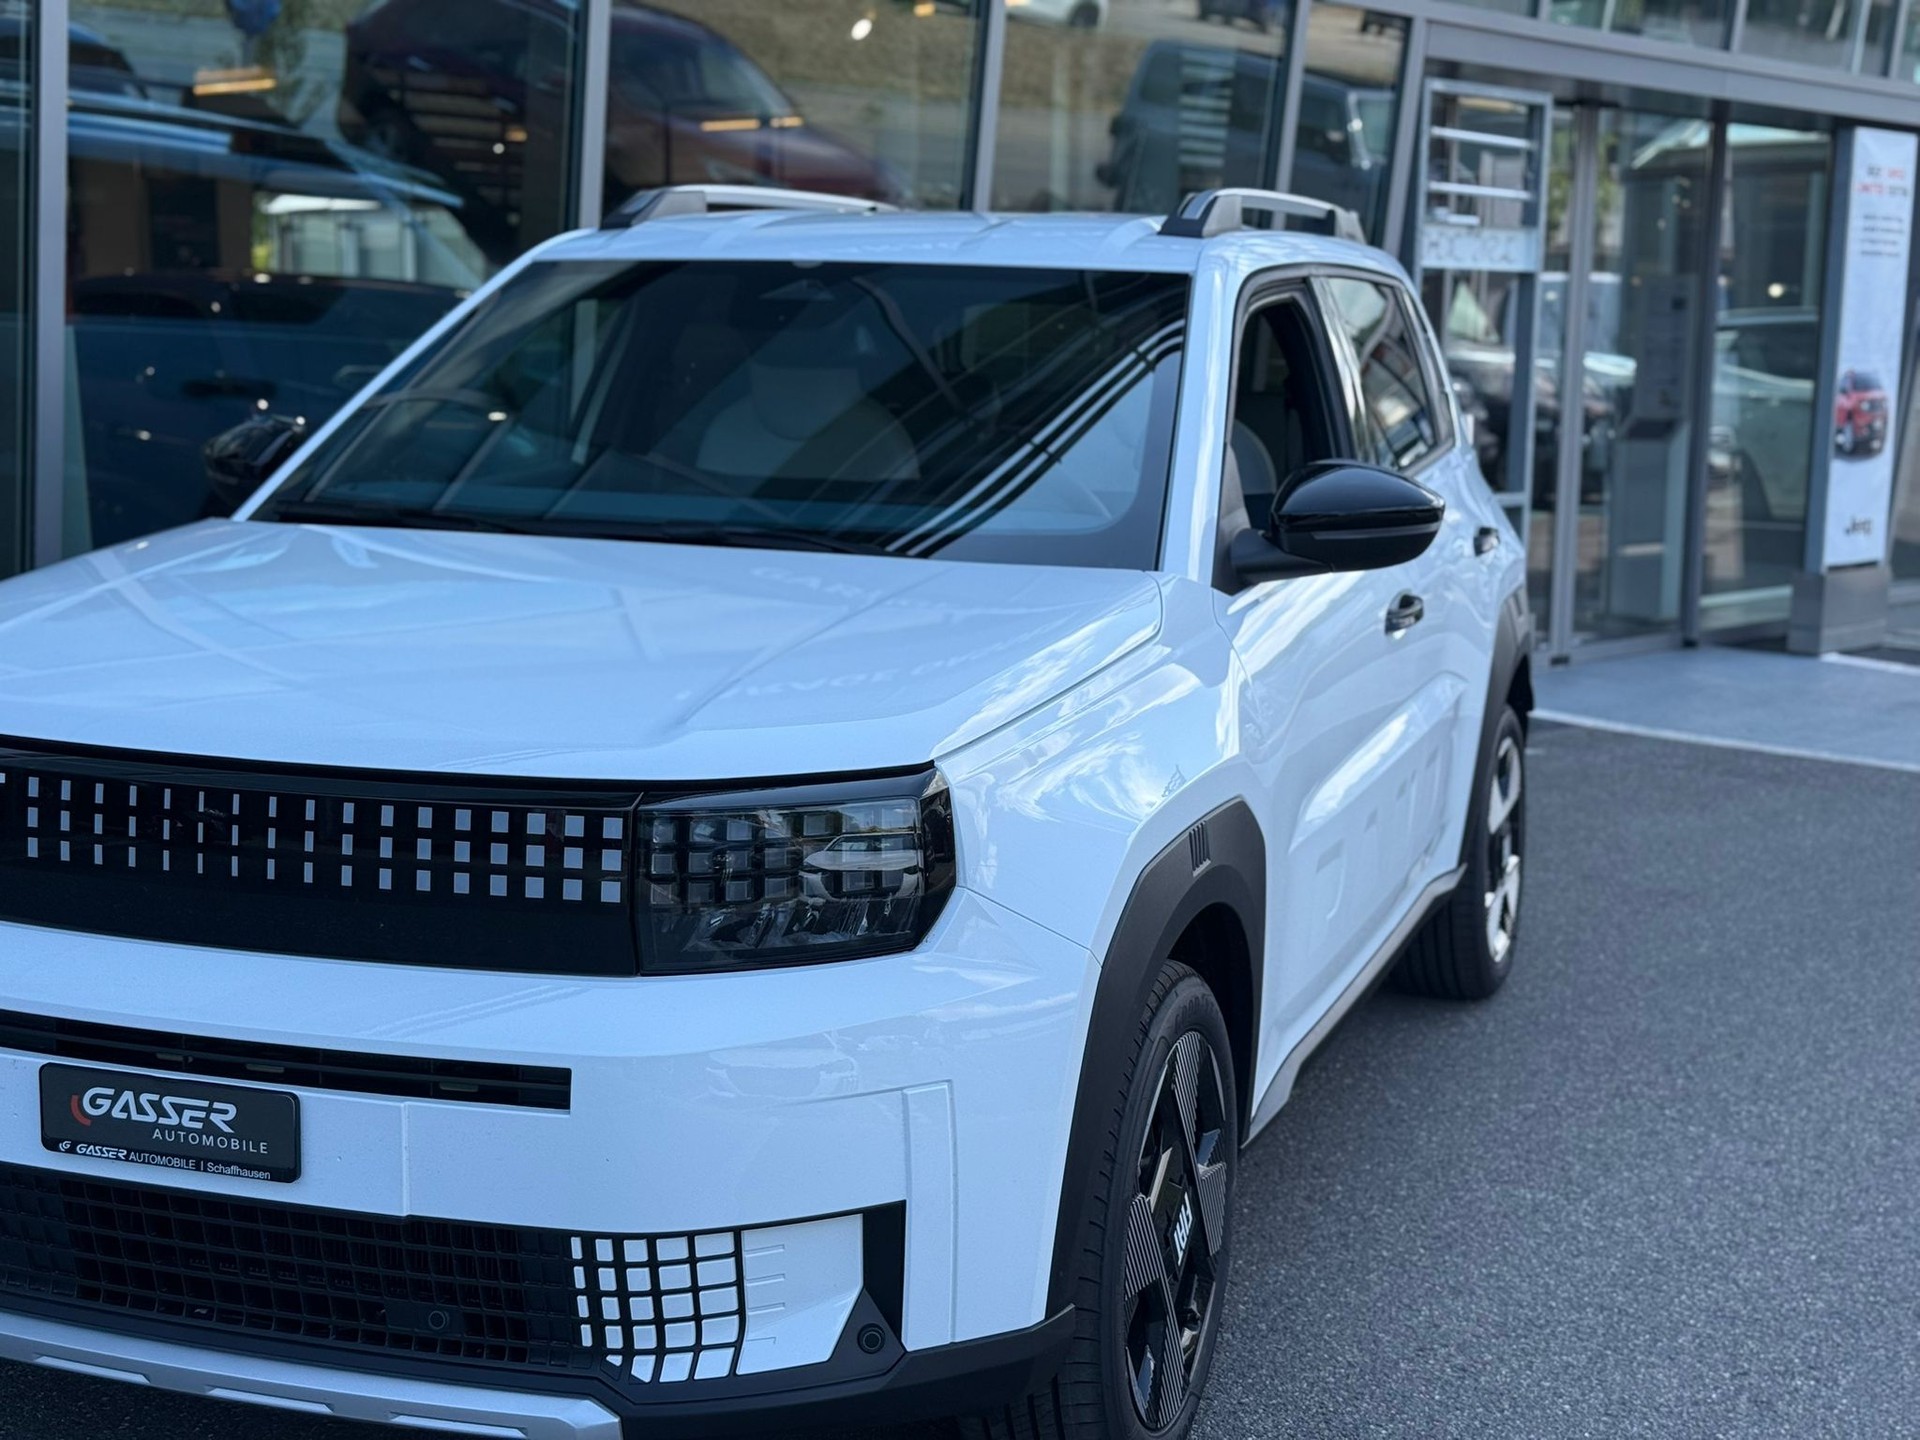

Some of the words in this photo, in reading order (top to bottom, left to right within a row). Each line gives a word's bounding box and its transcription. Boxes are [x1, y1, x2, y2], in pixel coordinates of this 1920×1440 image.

[82, 1086, 237, 1134] GASSER
[152, 1128, 268, 1154] AUTOMOBILE
[76, 1143, 127, 1160] GASSER
[128, 1151, 196, 1170] AUTOMOBILE
[206, 1161, 271, 1180] Schaffhausen
